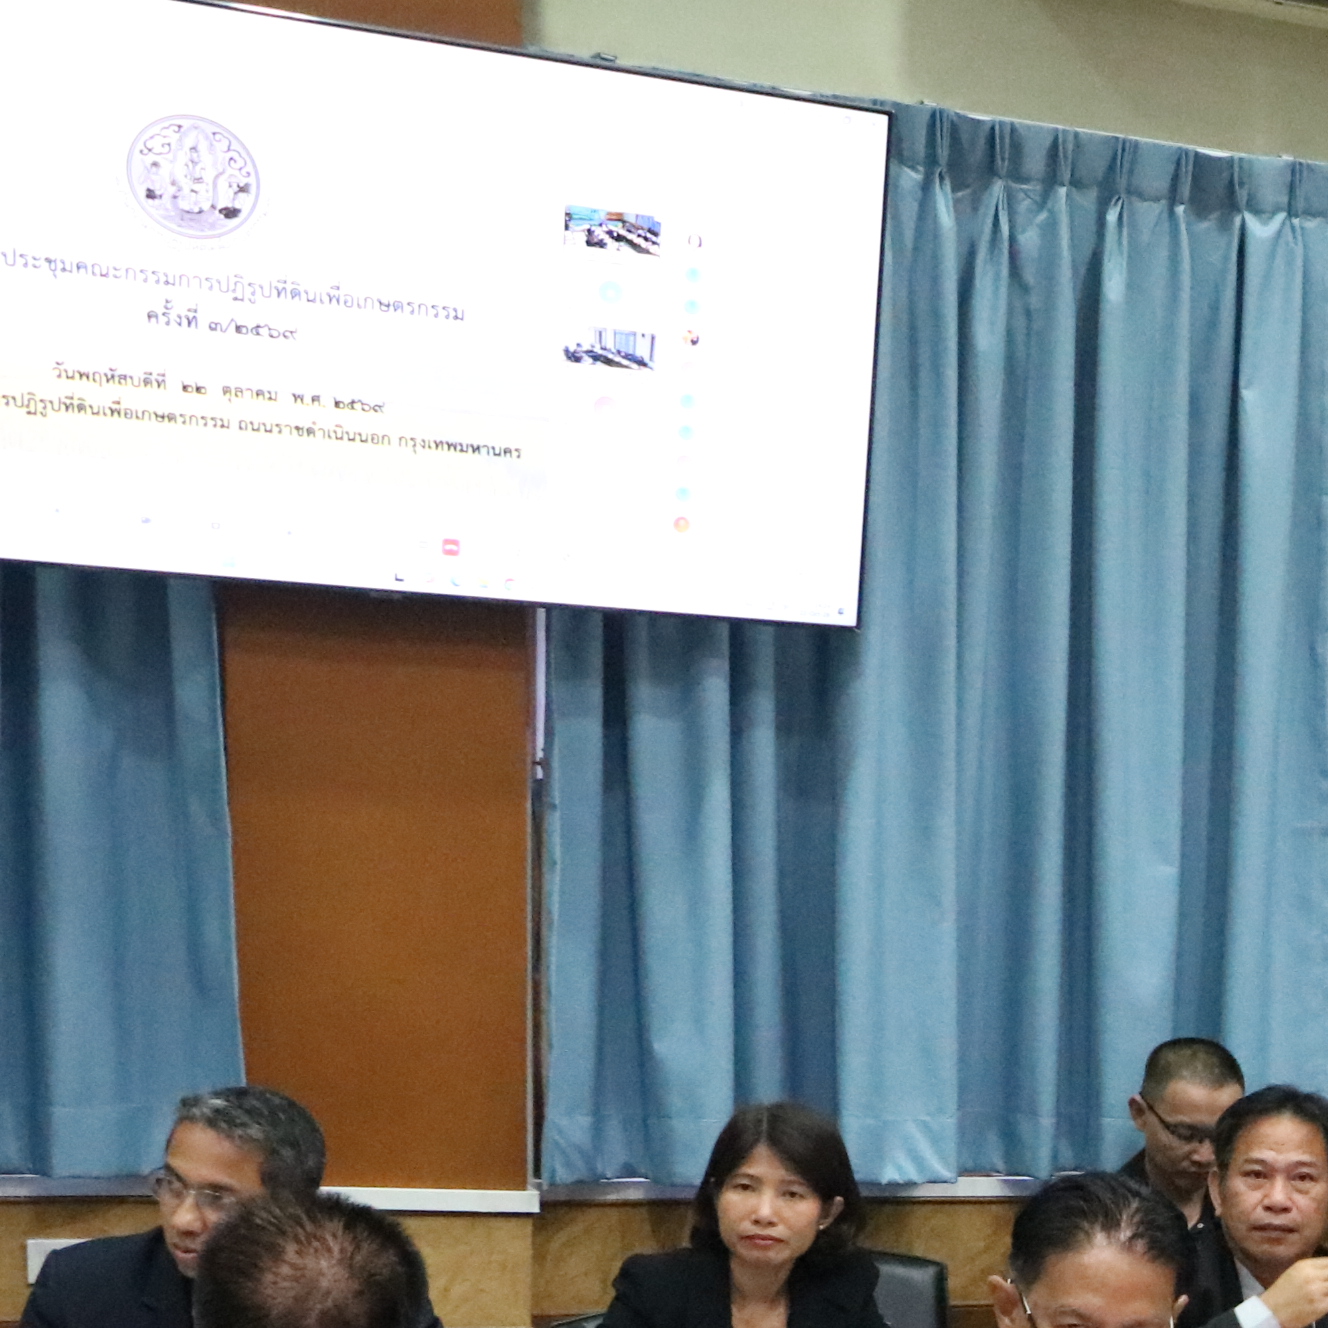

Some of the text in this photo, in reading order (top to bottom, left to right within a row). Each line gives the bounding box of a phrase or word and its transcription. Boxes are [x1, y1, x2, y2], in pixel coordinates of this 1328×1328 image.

[146, 299, 299, 342] ครั้งที่ ๓/๒๕๖๙
[52, 361, 167, 391] วันพฤหัสบดีที่
[181, 380, 207, 395] ๒๒
[222, 385, 278, 403] ตุลาคม
[238, 418, 391, 446] ถนนราชดำเนินนอก
[398, 434, 522, 460] กรุงเทพมหานคร
